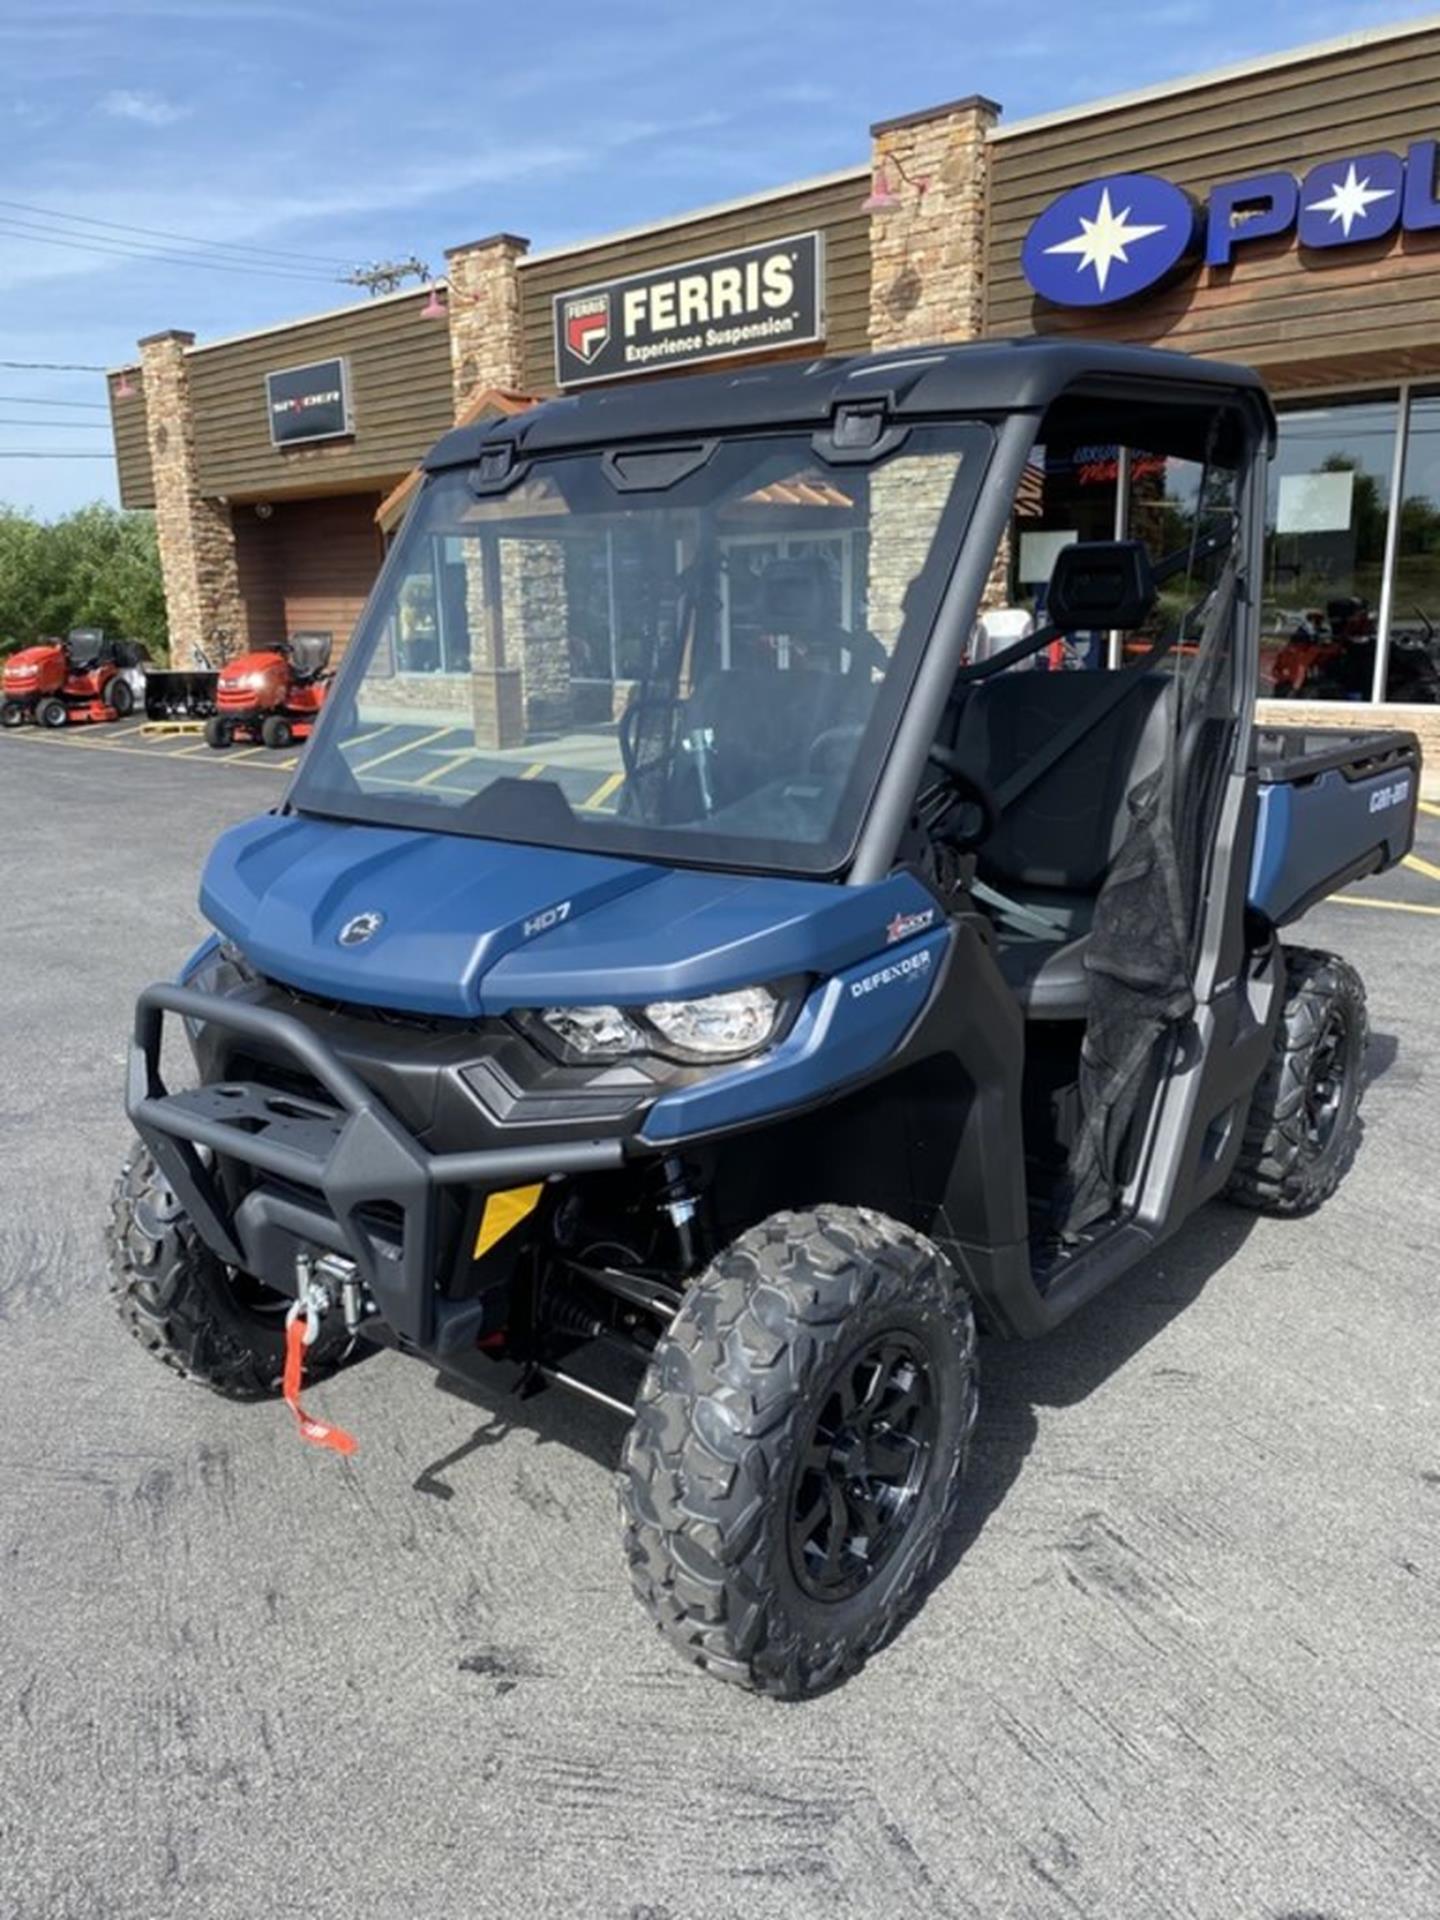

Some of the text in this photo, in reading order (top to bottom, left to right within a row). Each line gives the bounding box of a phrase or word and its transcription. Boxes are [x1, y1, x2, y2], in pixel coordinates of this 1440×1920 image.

[568, 299, 607, 320] FERRIS
[623, 253, 798, 338] FERRIS
[625, 315, 796, 363] Experience Suspension
[523, 900, 572, 937] HD7
[850, 949, 931, 998] DEFENDER
